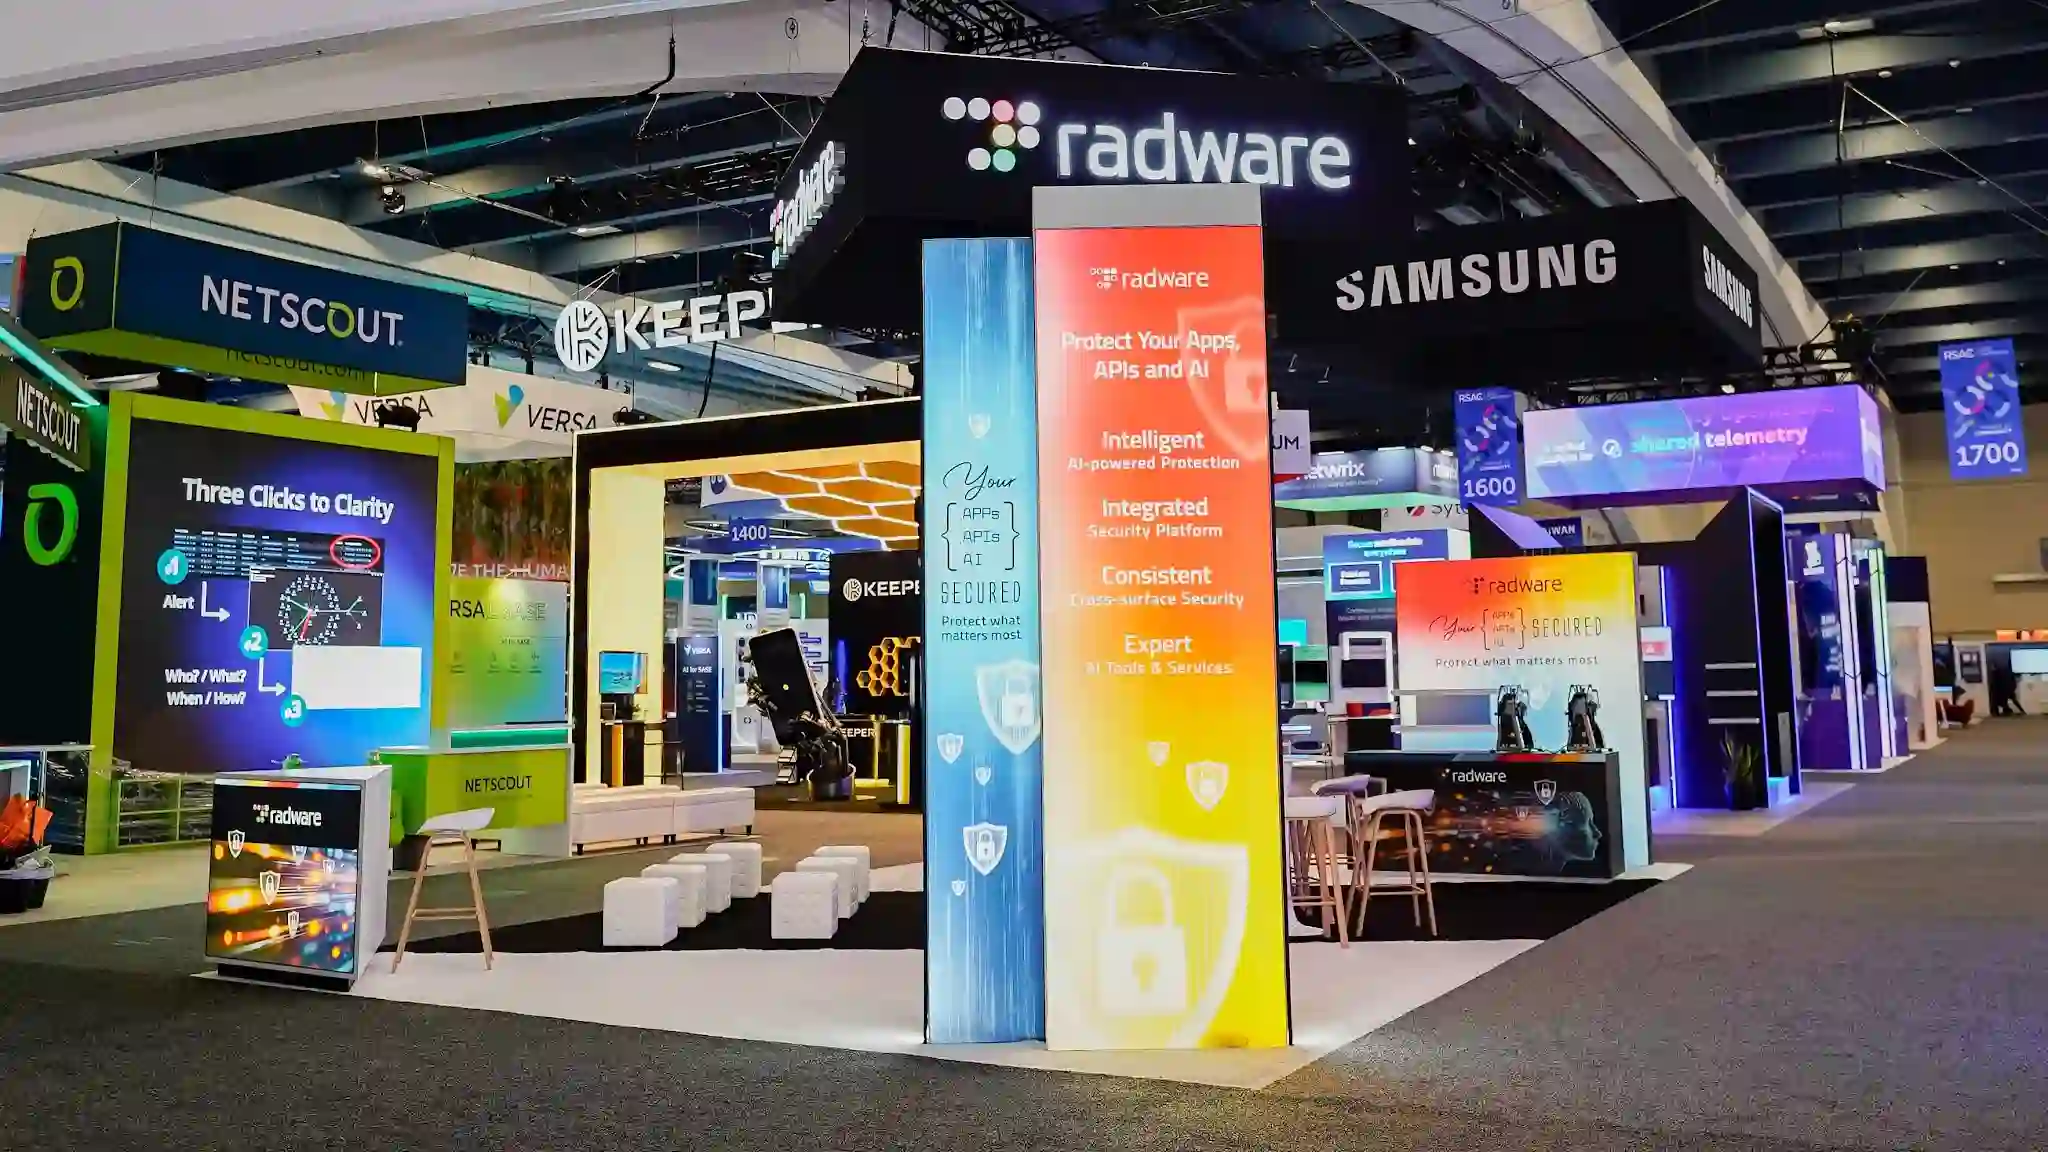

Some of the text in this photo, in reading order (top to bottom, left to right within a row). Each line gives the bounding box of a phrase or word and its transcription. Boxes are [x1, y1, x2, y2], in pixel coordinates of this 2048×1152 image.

[1056, 112, 1351, 189] radware
[1122, 267, 1209, 290] radware
[1336, 239, 1617, 312] SAMSUNG
[1703, 245, 1753, 328] SAMSUNG
[201, 274, 403, 346] NETSCOUT
[615, 288, 822, 353] KEEP
[1061, 330, 1240, 354] Protect Your Apps,
[1944, 348, 1975, 360] RSAC
[1094, 360, 1209, 379] APIs and AI
[17, 377, 80, 454] NETSCOUT
[528, 404, 597, 432] VERSA
[1102, 430, 1204, 453] Intelligent
[1705, 427, 1808, 448] telemetry
[1068, 455, 1239, 472] AI-powered Protection
[1957, 442, 2019, 466] 1700
[943, 461, 1016, 500] Your
[1464, 476, 1516, 498] 1600
[183, 477, 394, 524] Three Clicks to Clarity
[1102, 497, 1208, 521] Integrated
[963, 507, 1000, 520] APPs
[732, 525, 767, 541] 1400
[963, 530, 1000, 543] APIs
[1087, 524, 1223, 539] Security Platform
[963, 553, 982, 566] AI
[472, 564, 504, 578] THE
[1102, 566, 1212, 585] Consistent
[941, 581, 1021, 604] SECURED
[1489, 577, 1564, 594] radware
[163, 594, 195, 611] Alert
[1070, 591, 1244, 609] Cross-surface Security
[942, 615, 1021, 627] Protect what
[1429, 615, 1475, 641] Your
[1532, 617, 1602, 638] SECURED
[941, 630, 1021, 642] matters most
[1124, 634, 1192, 657] Expert
[1151, 662, 1160, 674] &
[1167, 661, 1233, 675] Services
[1436, 655, 1598, 669] Protect what matters most
[165, 669, 200, 684] Who?
[209, 669, 247, 684] What?
[167, 691, 203, 706] When
[214, 691, 247, 705] How?
[465, 776, 532, 794] NETSCOUT
[1452, 768, 1507, 783] radware
[269, 806, 322, 828] radware
